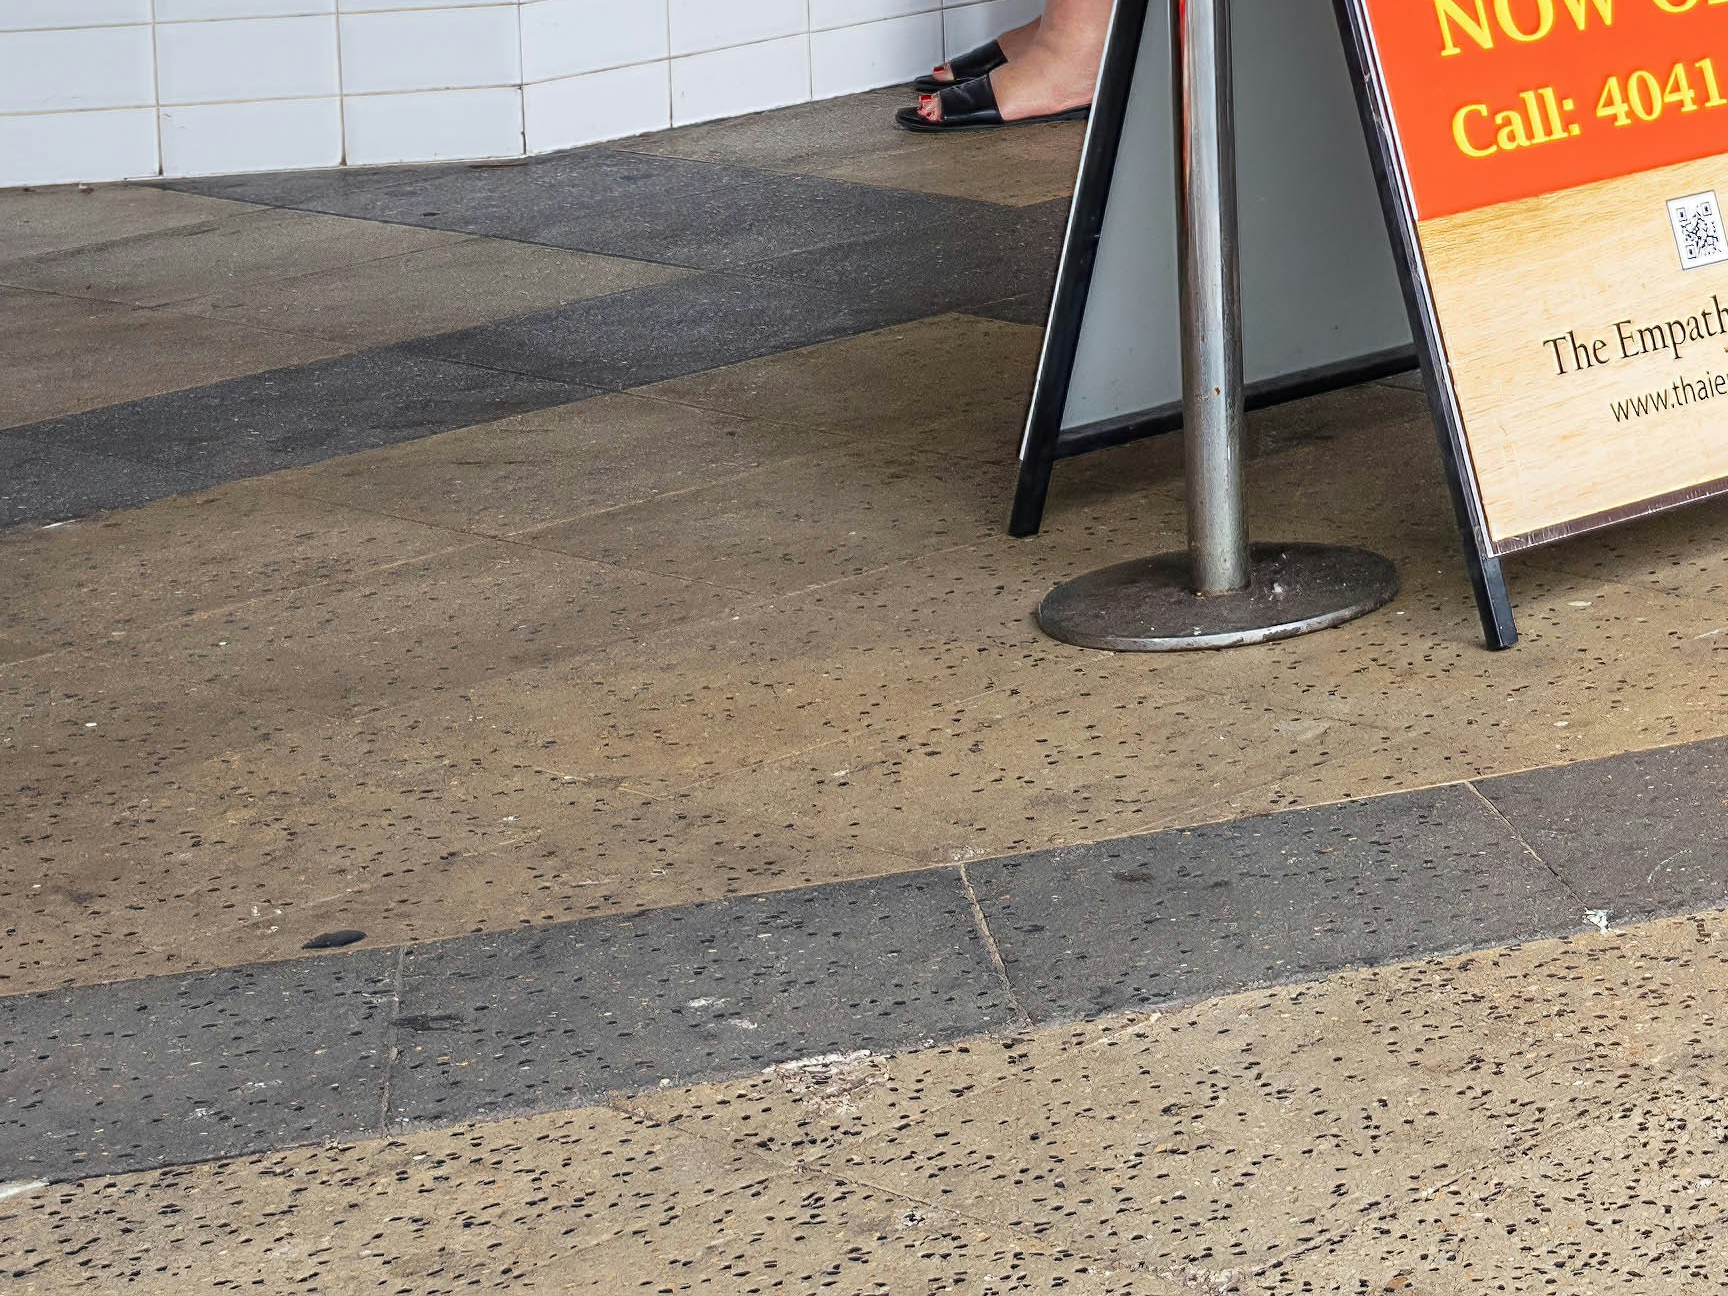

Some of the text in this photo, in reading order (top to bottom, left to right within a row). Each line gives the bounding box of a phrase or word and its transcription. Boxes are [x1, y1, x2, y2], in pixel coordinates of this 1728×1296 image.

[1452, 87, 1581, 158] Call:
[1595, 58, 1728, 127] 4041
[1543, 330, 1610, 376] The
